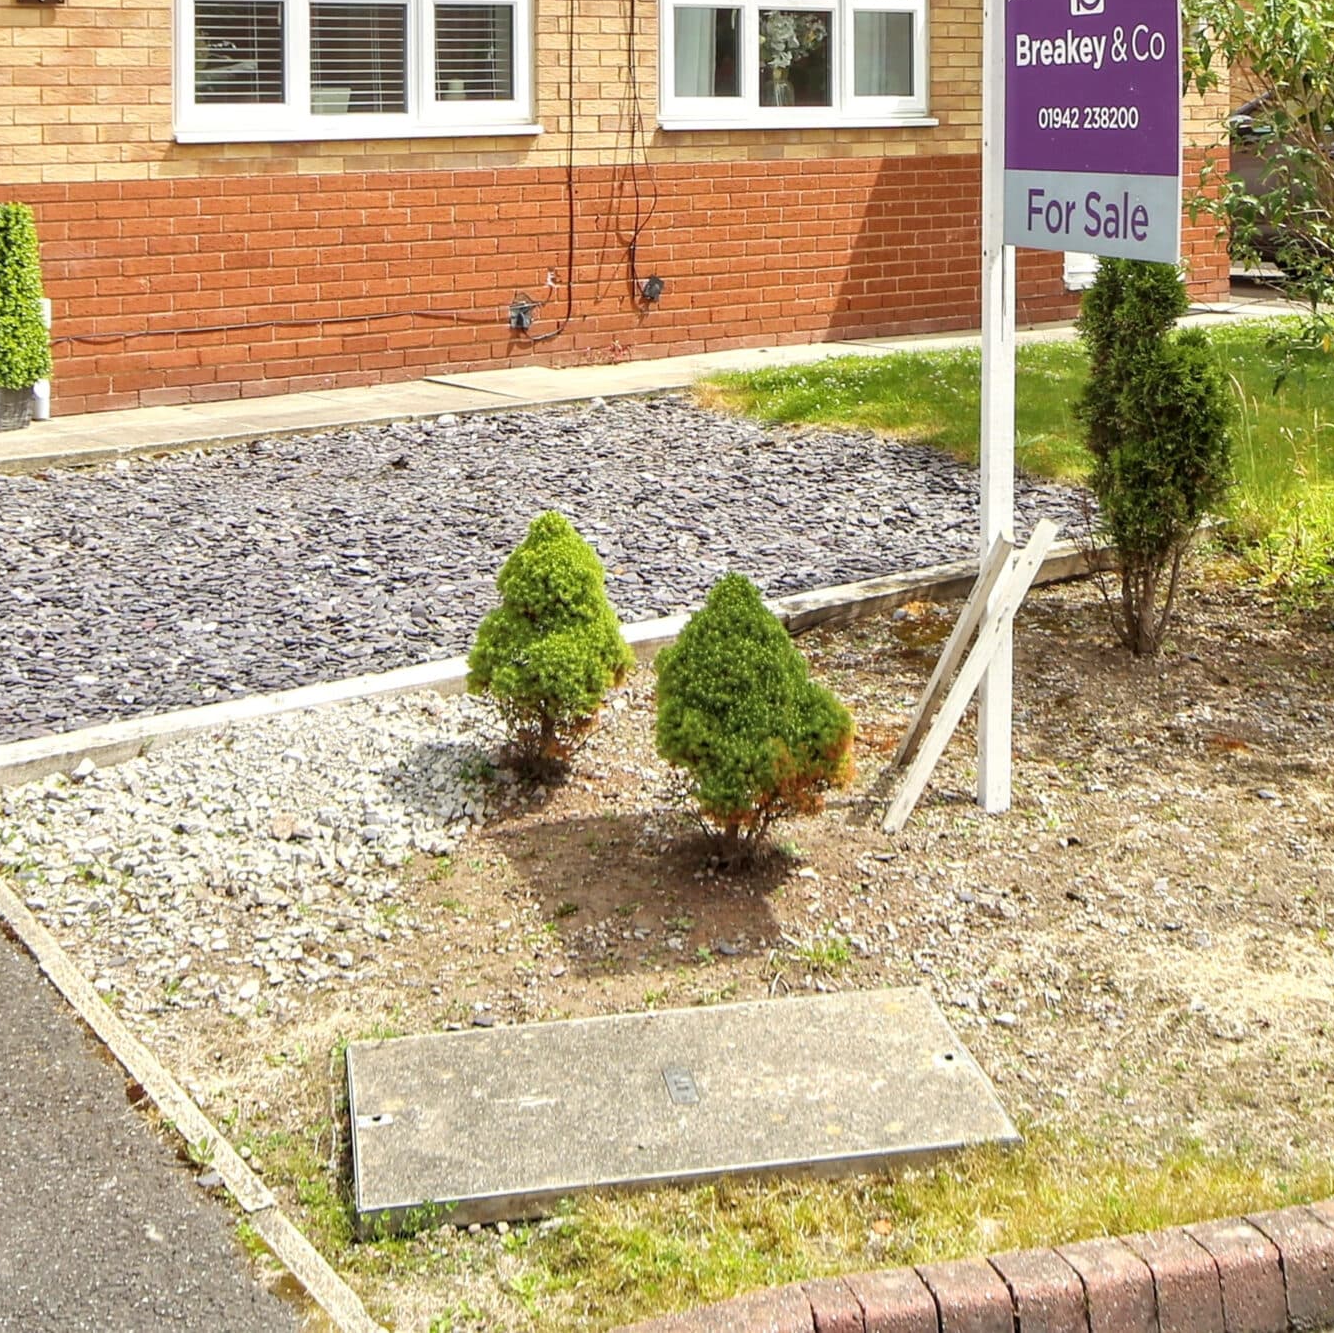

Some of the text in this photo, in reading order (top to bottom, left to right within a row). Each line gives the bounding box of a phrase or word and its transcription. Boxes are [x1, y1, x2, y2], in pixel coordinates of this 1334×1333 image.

[1015, 23, 1166, 70] Breakey & Co
[1038, 106, 1139, 130] 01942 238200
[1027, 188, 1149, 241] For Sale
